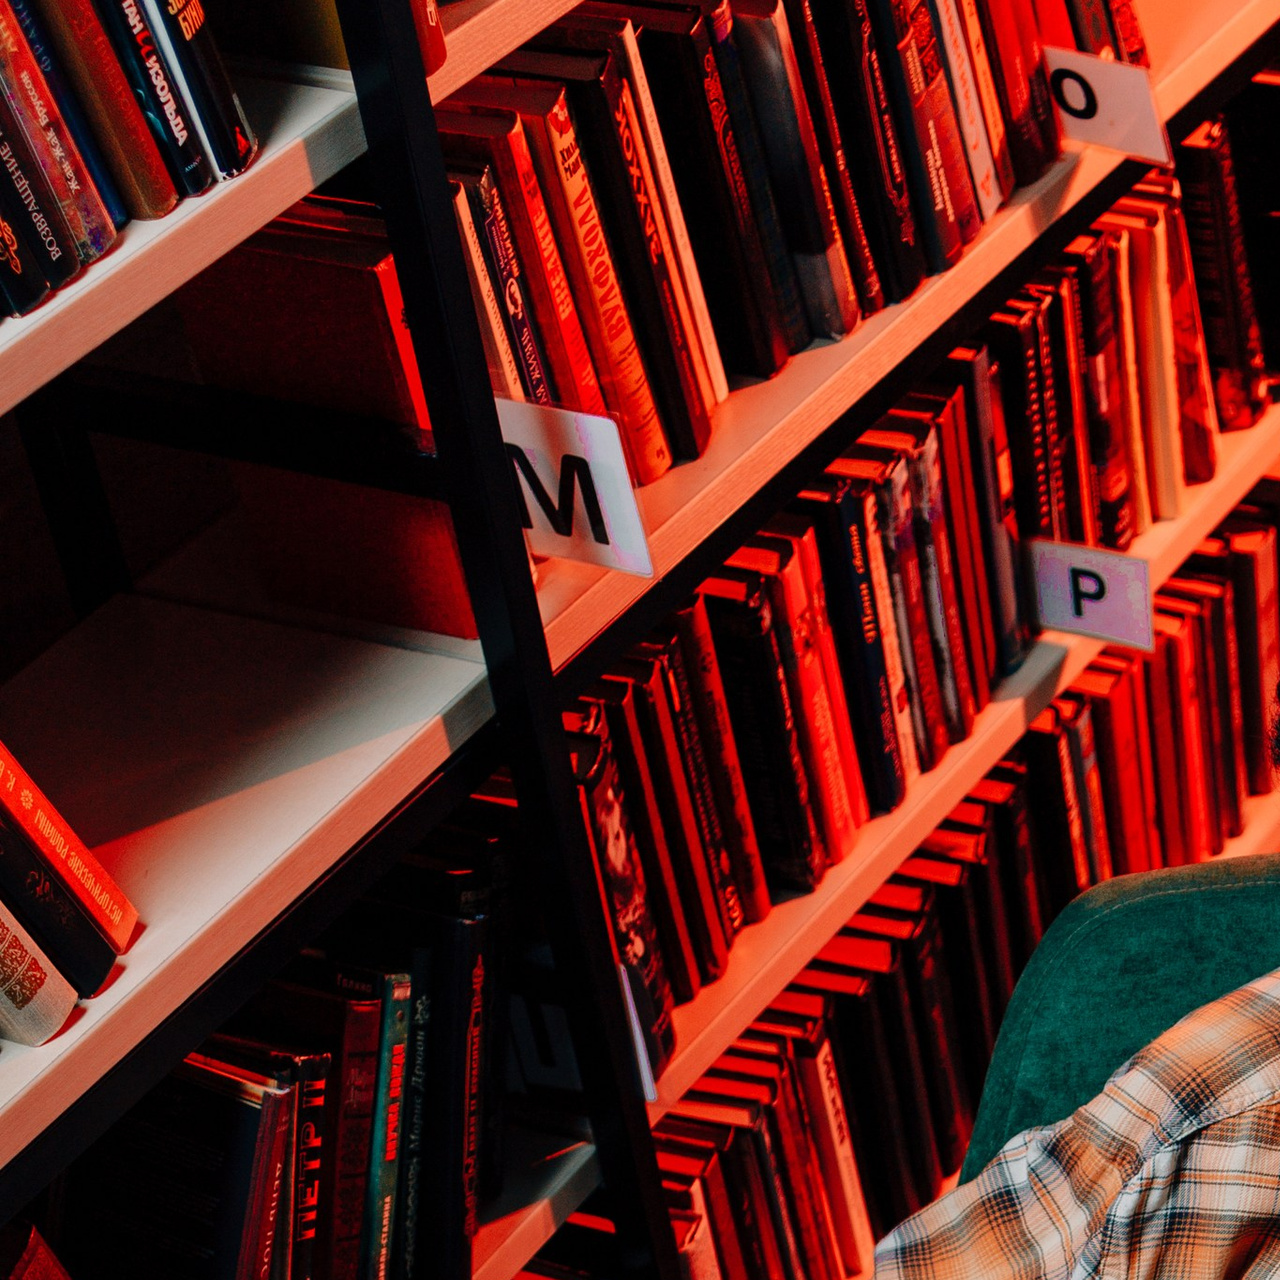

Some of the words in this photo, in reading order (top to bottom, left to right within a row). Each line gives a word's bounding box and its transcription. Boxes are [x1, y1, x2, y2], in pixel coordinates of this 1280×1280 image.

[20, 71, 49, 127] Бруссон
[147, 55, 187, 147] ИЗОЛЬДА
[1050, 68, 1097, 119] О
[46, 128, 81, 195] Жан-Жак
[614, 90, 661, 265] ЗАХХОК
[0, 141, 61, 262] ВОЗВРАЩЕНИЕ
[504, 443, 610, 546] М
[1069, 569, 1105, 616] Р
[34, 808, 67, 860] РОМАНЫ
[68, 852, 123, 926] ИСТОРИЧЕСКИЕ
[269, 1161, 285, 1225] ДЕНЬ
[297, 1122, 324, 1242] ПЕТР
